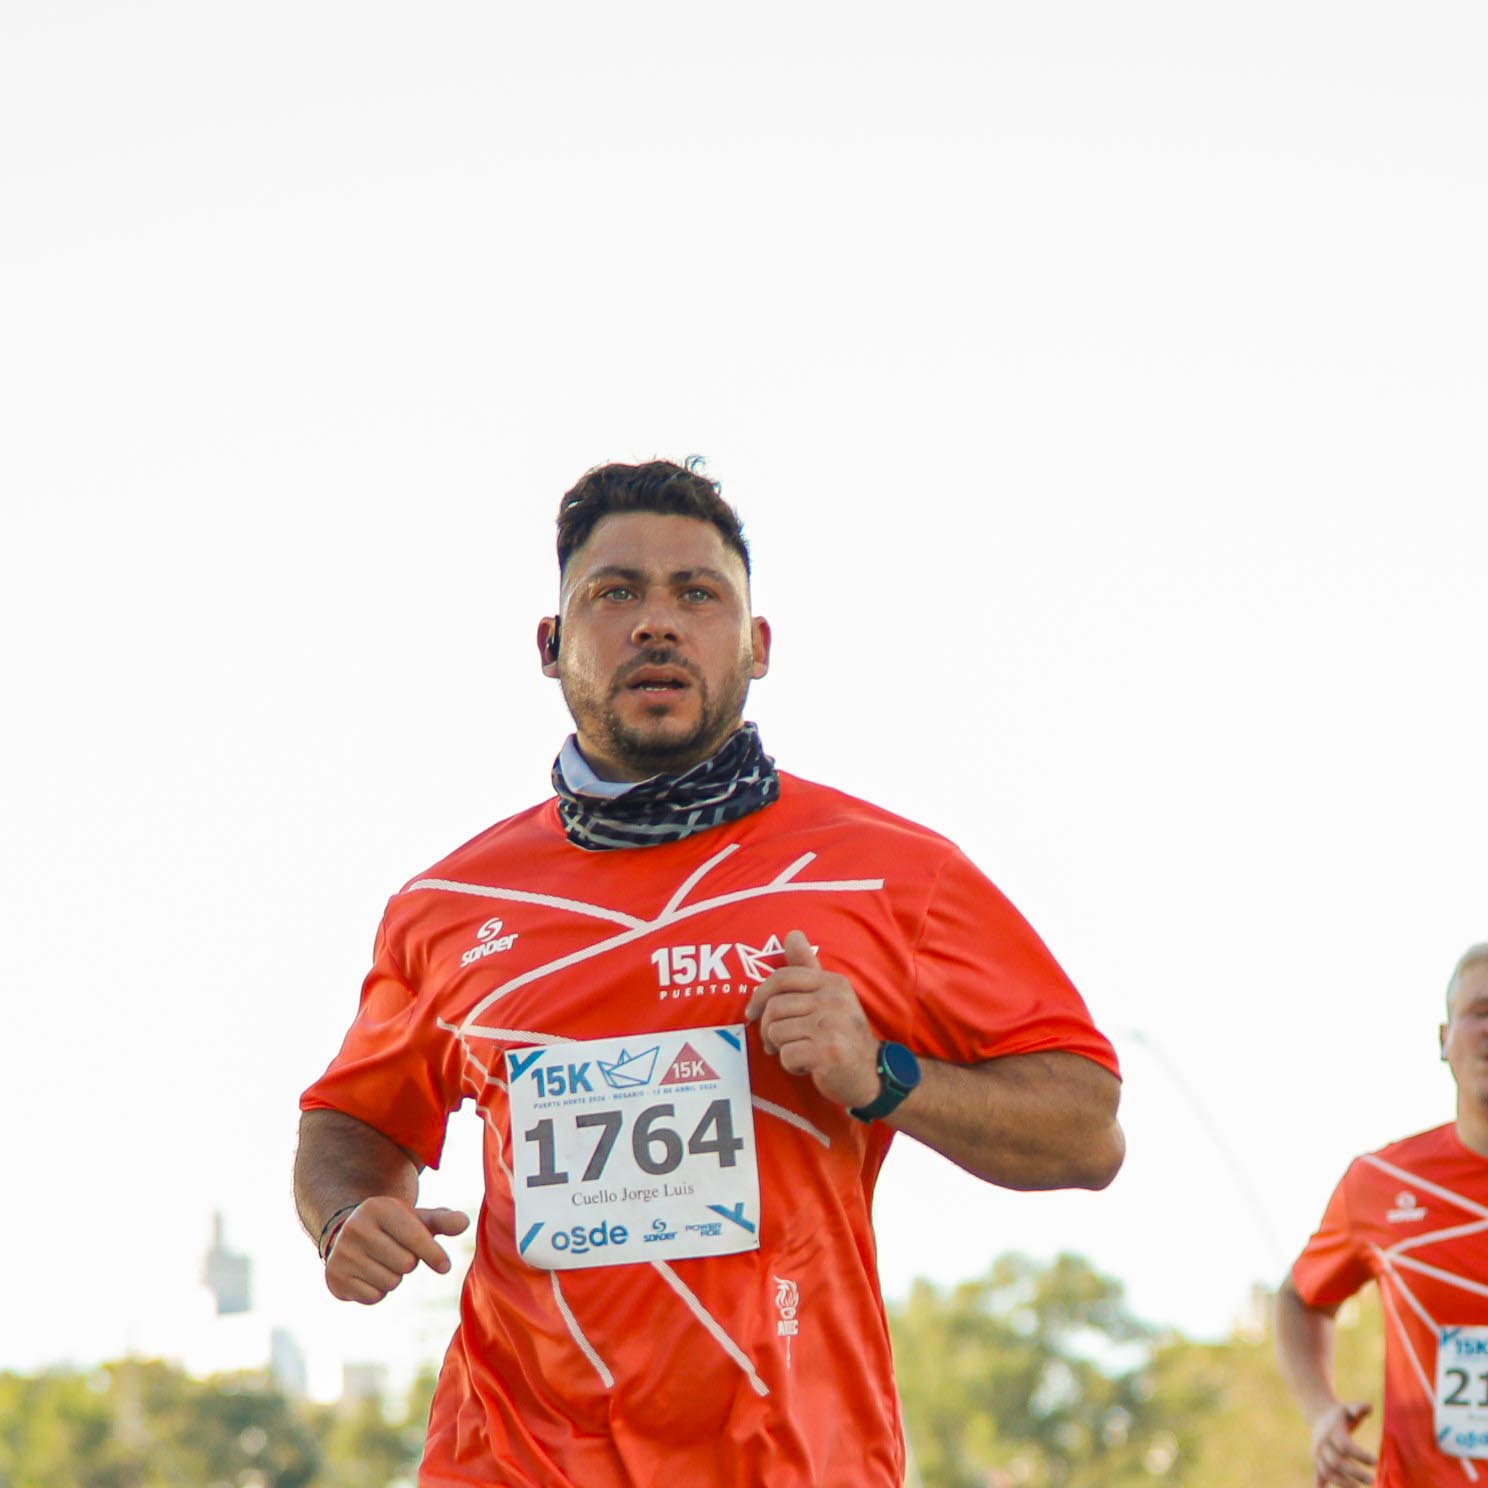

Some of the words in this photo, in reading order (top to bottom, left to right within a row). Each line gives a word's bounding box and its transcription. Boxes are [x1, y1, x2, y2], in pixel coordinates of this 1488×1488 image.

[651, 943, 732, 987] 15K
[659, 983, 730, 1000] PUERTO
[531, 1061, 594, 1098] 15K
[672, 1059, 706, 1080] 15K
[525, 1098, 744, 1188] 1764
[571, 1188, 618, 1207] Cuello
[621, 1186, 659, 1203] Jorge
[664, 1183, 694, 1198] Luis
[551, 1219, 629, 1252] osde
